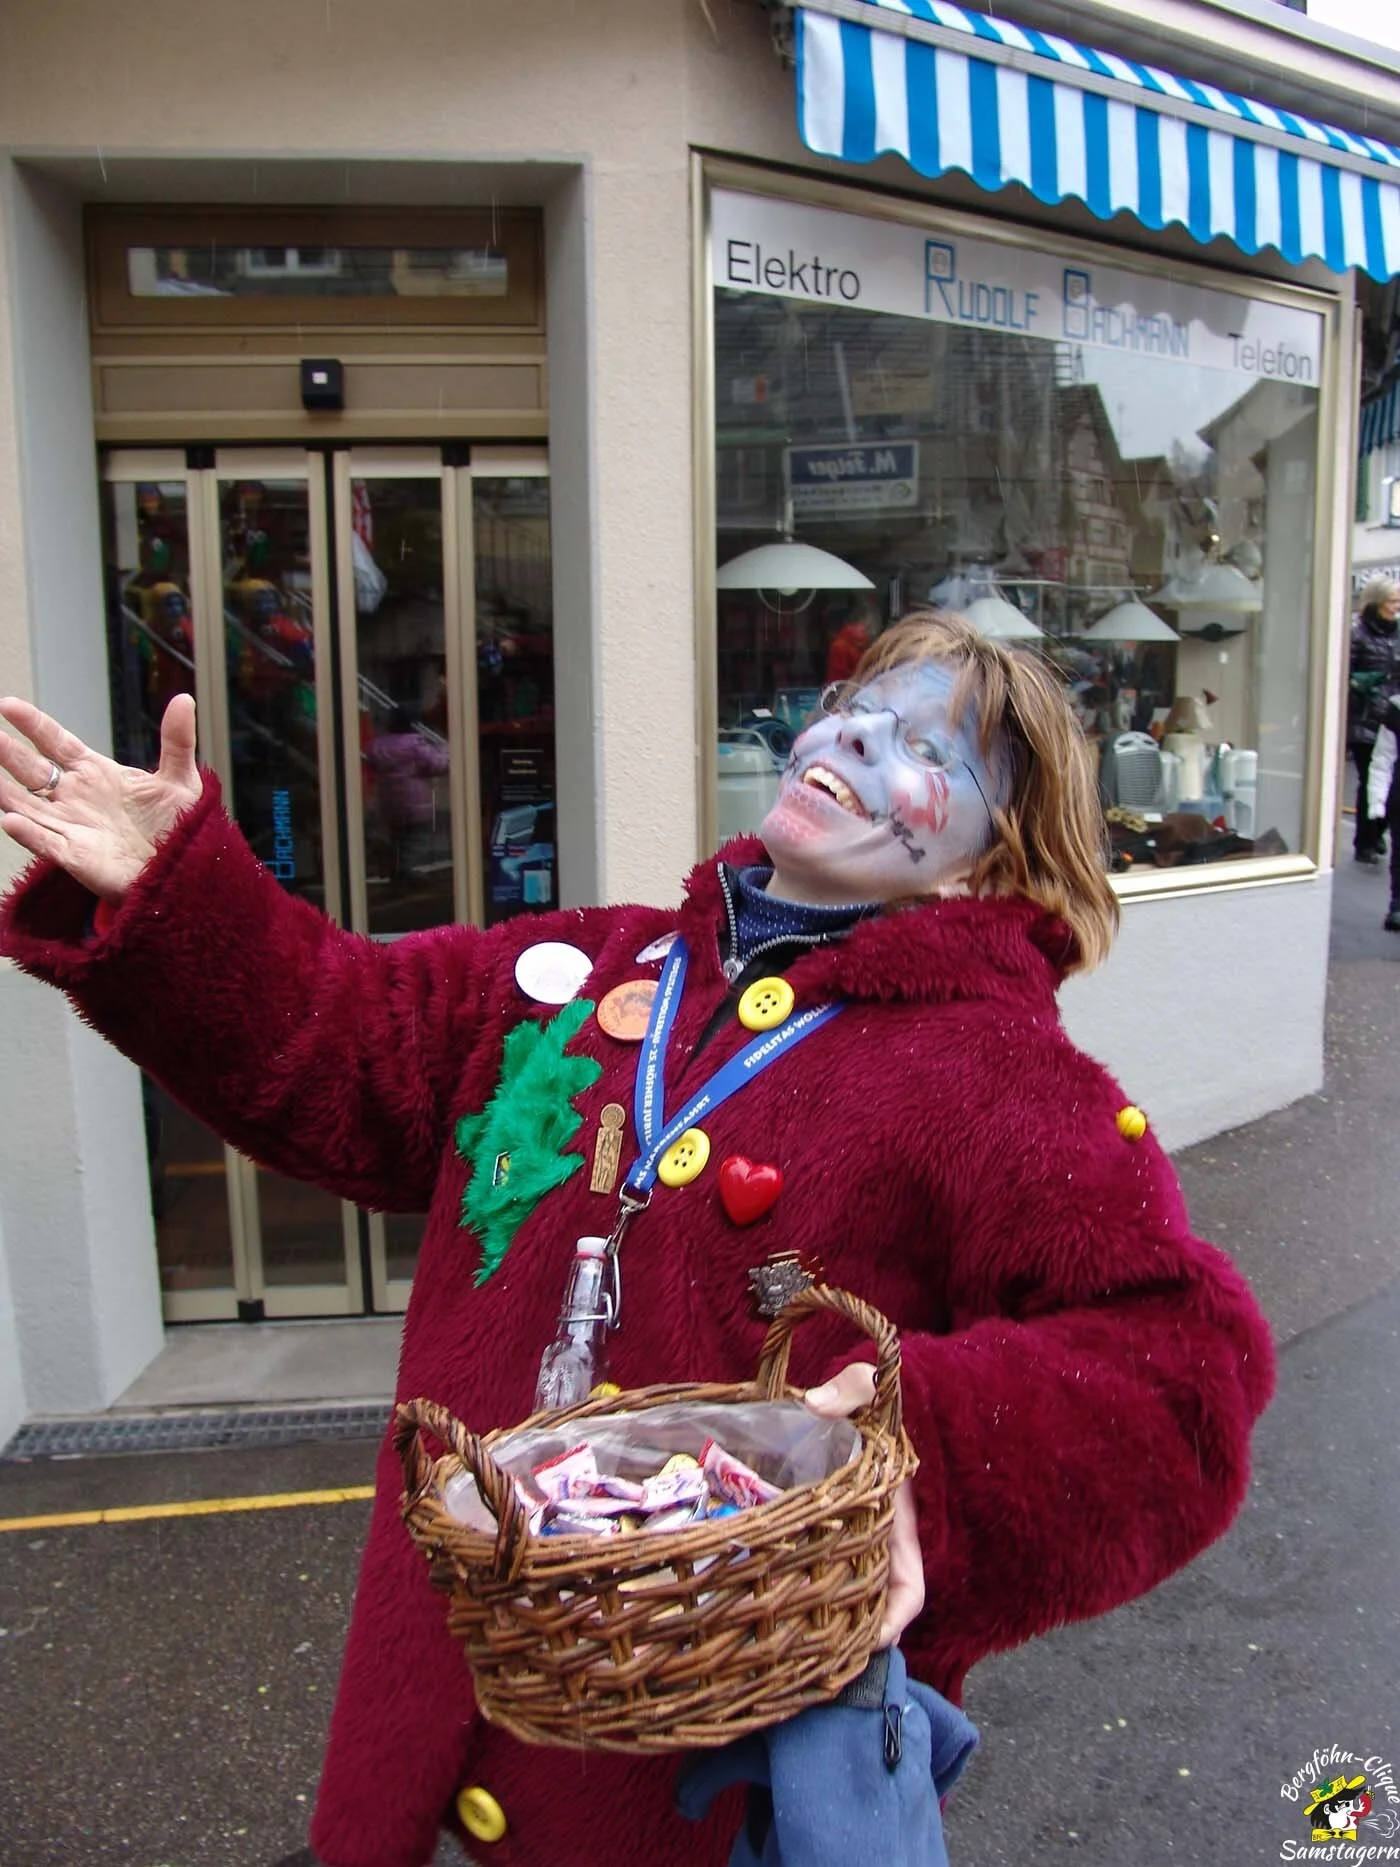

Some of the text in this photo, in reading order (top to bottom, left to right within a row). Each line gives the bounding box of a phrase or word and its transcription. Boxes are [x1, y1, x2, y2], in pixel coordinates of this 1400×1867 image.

[727, 239, 860, 300] Elektro
[924, 239, 1190, 358] RUDOLF BACHMANN
[1227, 332, 1313, 381] Telefon
[743, 1025, 796, 1068] FIDELITAS
